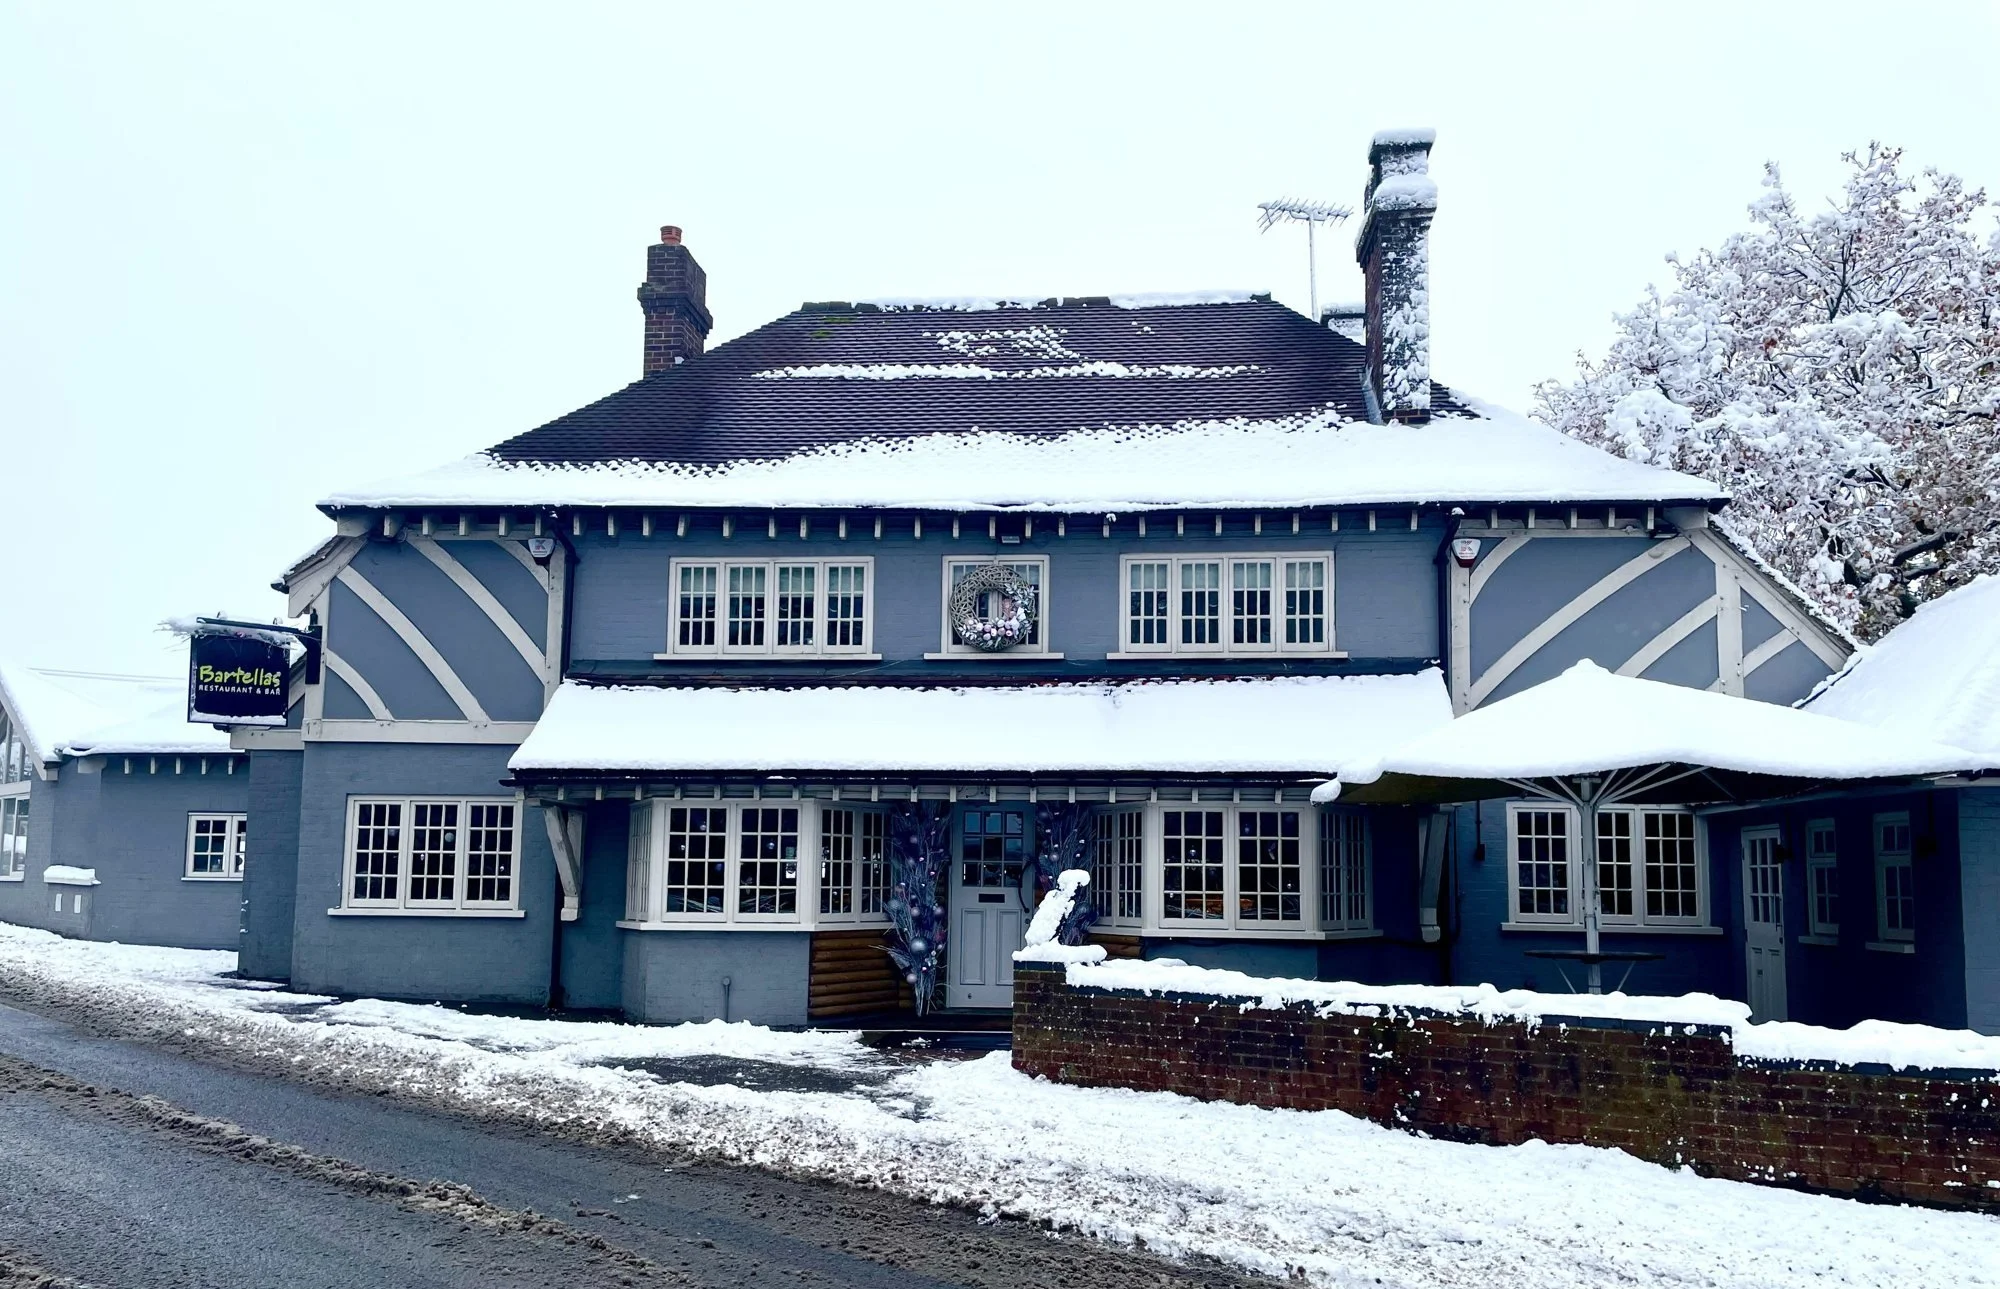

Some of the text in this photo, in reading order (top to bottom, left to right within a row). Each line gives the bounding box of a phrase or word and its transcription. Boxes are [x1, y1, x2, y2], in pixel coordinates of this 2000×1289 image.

[199, 665, 282, 687] Bartellas
[198, 684, 253, 694] RESTAURANT
[264, 687, 281, 696] BAR
